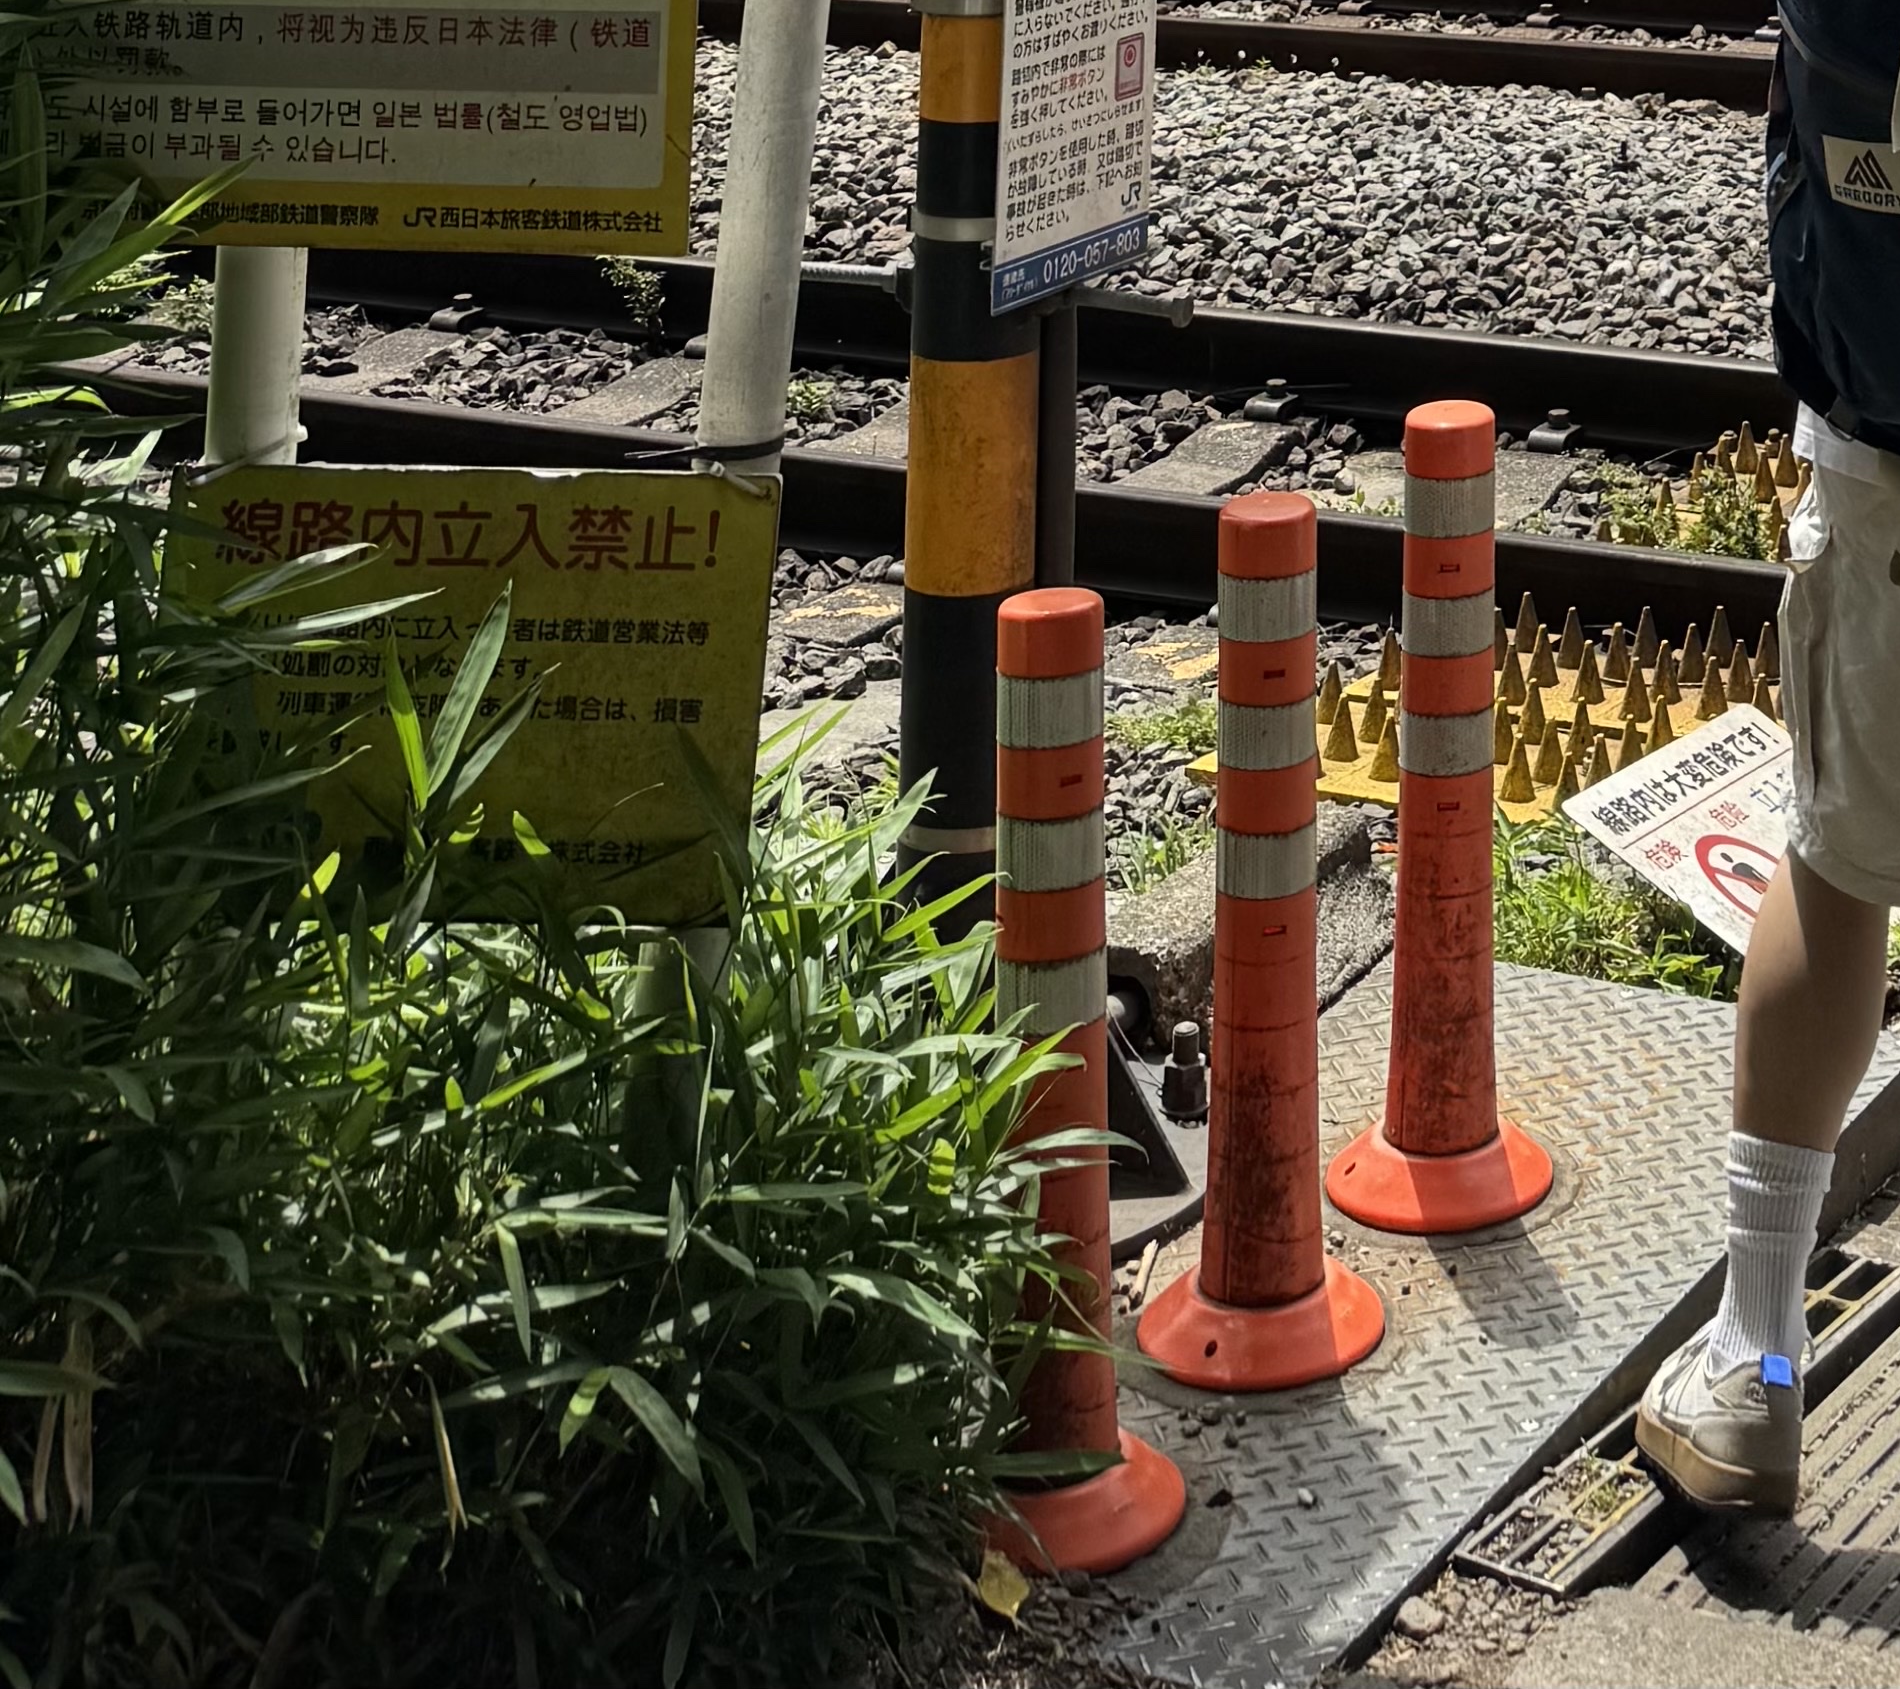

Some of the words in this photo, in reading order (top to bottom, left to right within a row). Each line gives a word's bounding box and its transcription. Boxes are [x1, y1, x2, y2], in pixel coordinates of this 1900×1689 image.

[170, 96, 246, 123] 함부로
[257, 97, 360, 127] 들어가면
[373, 100, 422, 129] 일본
[559, 104, 648, 138] 영업법)
[164, 133, 242, 161] 부과될
[286, 135, 397, 164] 있습니다.
[1121, 181, 1142, 207] JR
[1042, 226, 1141, 284] 0120-057-803
